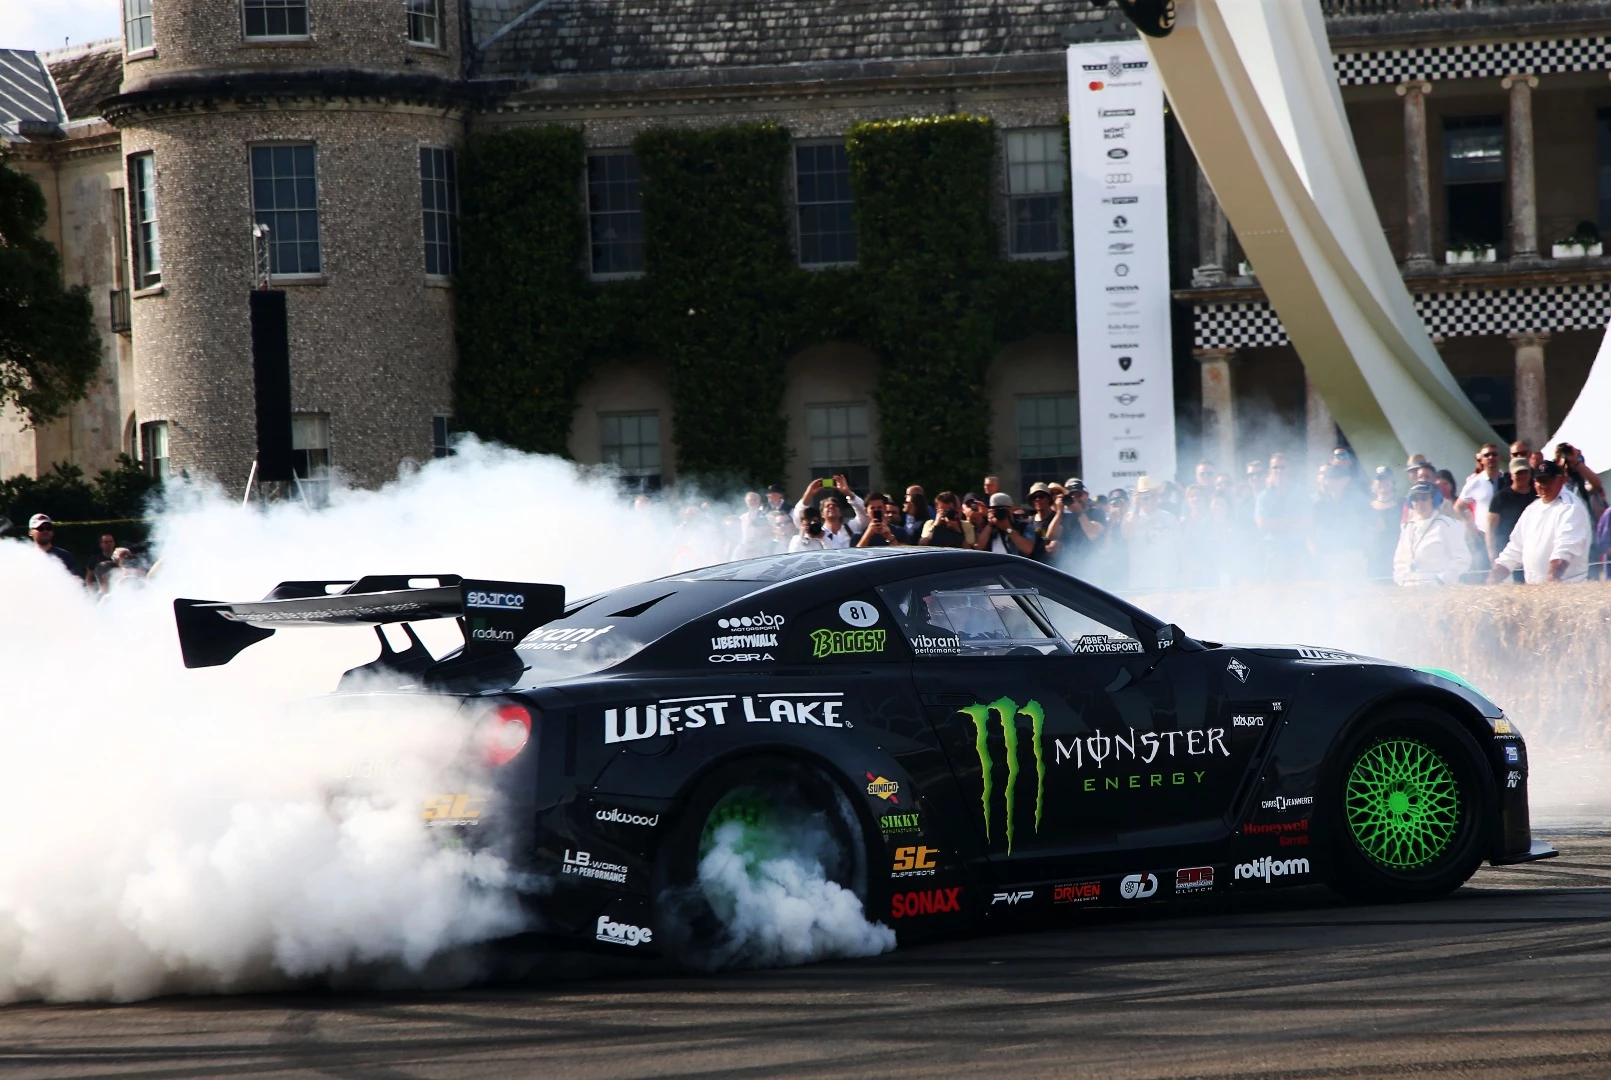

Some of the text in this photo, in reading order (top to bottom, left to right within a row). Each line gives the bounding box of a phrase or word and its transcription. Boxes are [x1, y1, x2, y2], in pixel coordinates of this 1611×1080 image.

[1120, 451, 1138, 460] FIA
[467, 591, 525, 607] sparco
[752, 611, 785, 630] obp
[850, 606, 868, 620] 81
[472, 627, 514, 640] radium
[711, 633, 779, 651] LIBERTYWALK
[910, 634, 960, 647] vibrant
[1080, 635, 1107, 644] ABBEY
[810, 628, 886, 658] BAGGSY
[1074, 642, 1139, 653] MOTORSPORT
[708, 652, 775, 662] COBRA
[605, 696, 843, 744] WEST LAKE
[1055, 727, 1230, 769] MONSTER
[868, 782, 898, 793] SUNOCO
[1084, 770, 1205, 791] ENERGY
[595, 808, 659, 827] wilwood
[880, 813, 920, 828] SIKKY
[1243, 818, 1309, 835] Honeywell
[578, 866, 627, 883] PERFORMANCE
[1234, 856, 1310, 884] rotiform
[1054, 885, 1100, 902] DRIVEN
[891, 887, 960, 919] SONAX
[597, 915, 653, 946] Forge
